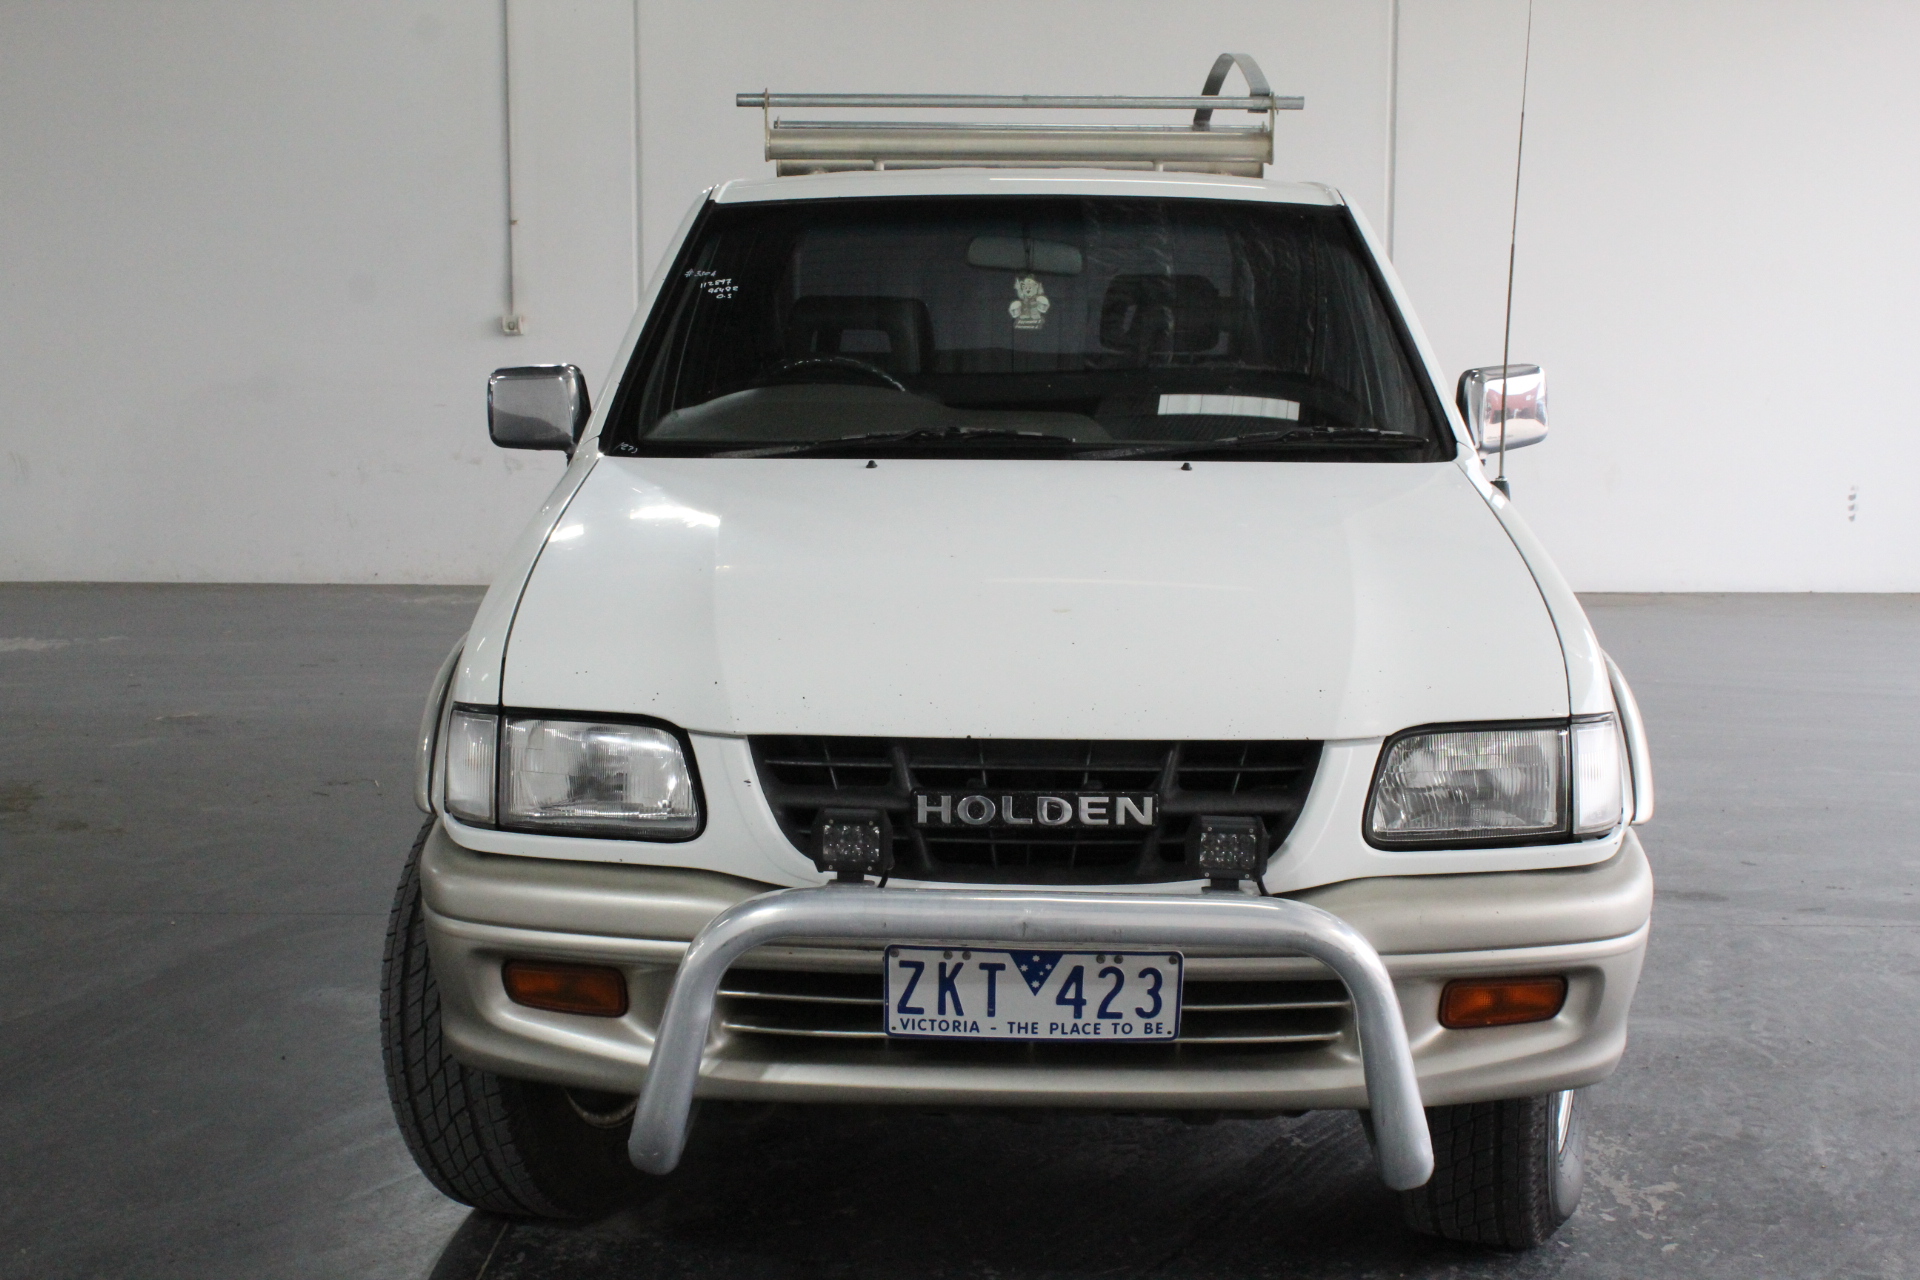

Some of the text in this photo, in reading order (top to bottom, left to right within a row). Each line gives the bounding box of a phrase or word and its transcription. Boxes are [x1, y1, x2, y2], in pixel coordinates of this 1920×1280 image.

[917, 795, 1153, 825] HOLDEN
[897, 959, 1163, 1020] ZKT 423
[899, 1017, 980, 1033] VICTORIA
[1007, 1021, 1039, 1035] THE
[1049, 1022, 1101, 1035] PLACE
[1111, 1022, 1133, 1035] TO
[1143, 1022, 1163, 1035] BE
